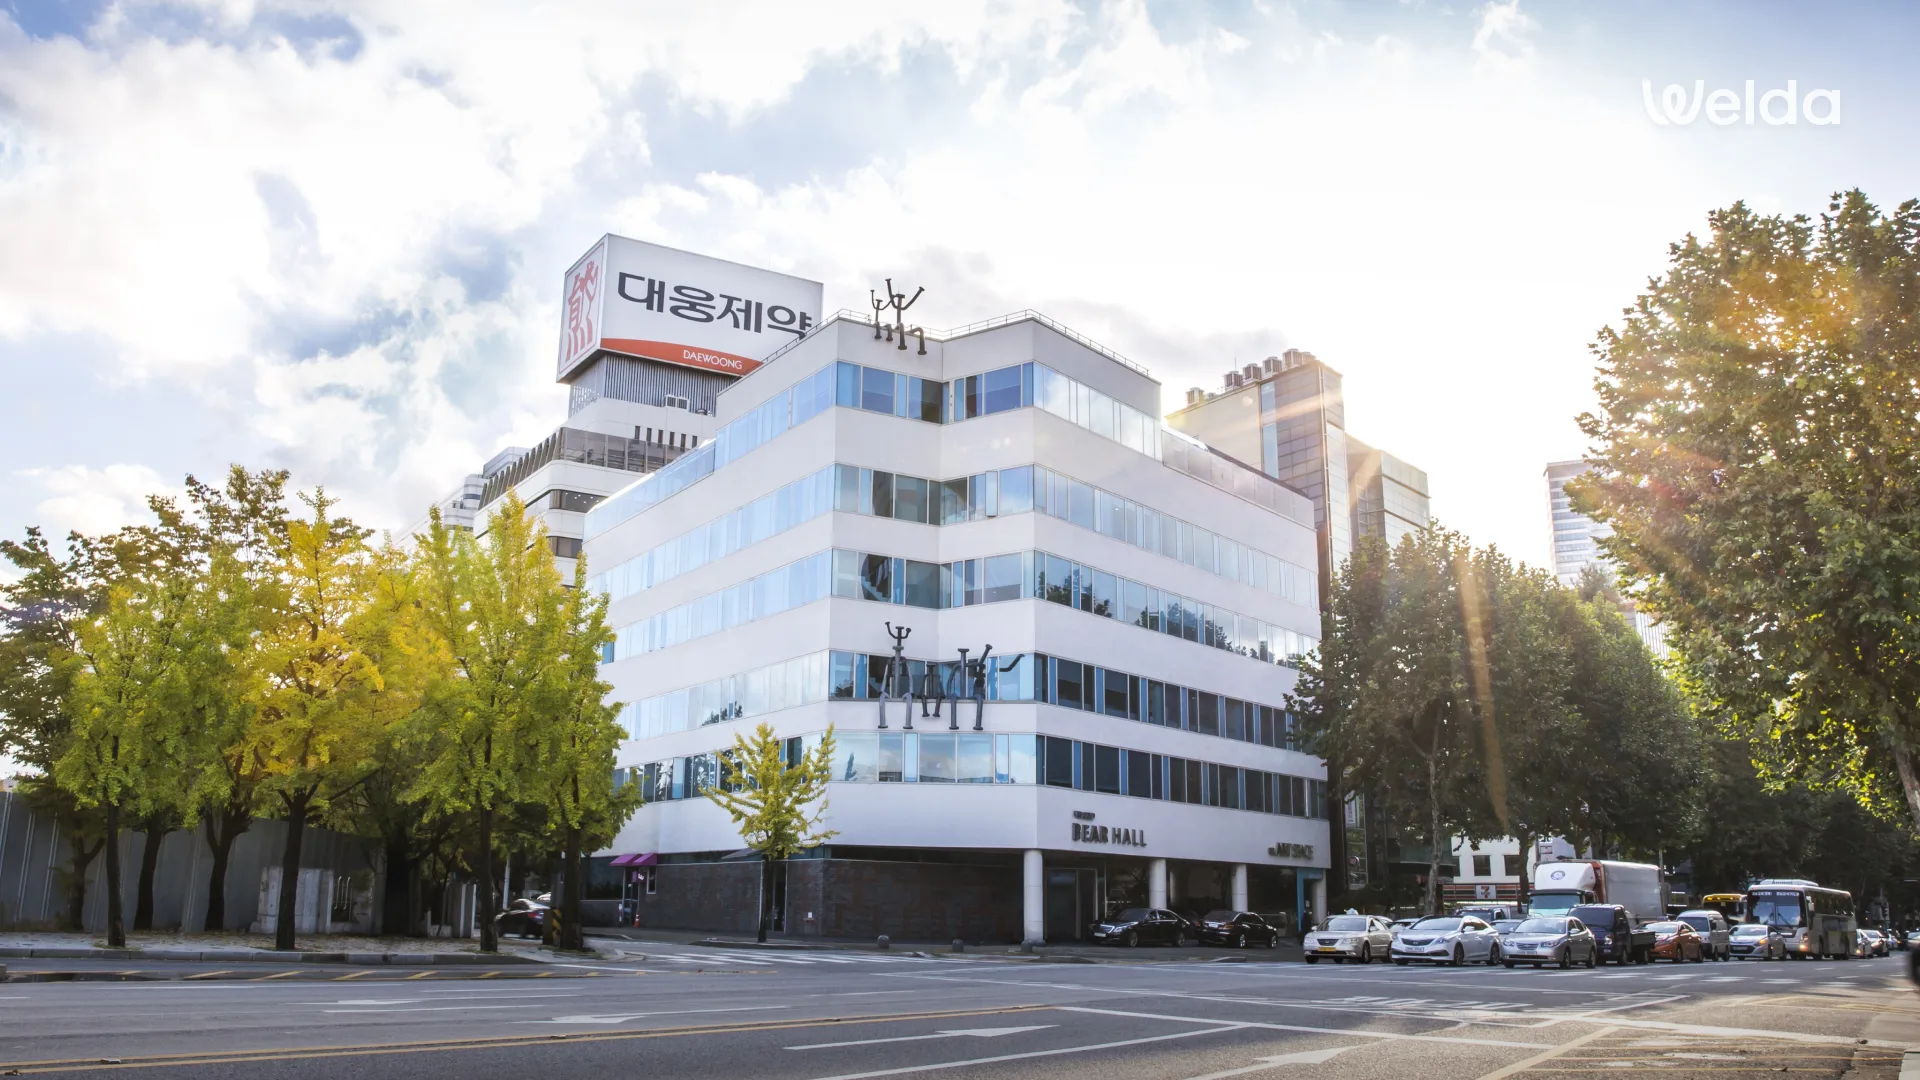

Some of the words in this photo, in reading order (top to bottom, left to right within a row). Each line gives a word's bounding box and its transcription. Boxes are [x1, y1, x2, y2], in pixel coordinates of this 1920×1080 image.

[617, 271, 812, 340] 대웅제약
[683, 349, 743, 370] DAEWOONG
[1072, 822, 1109, 844] BEAR
[1111, 827, 1147, 847] HALL
